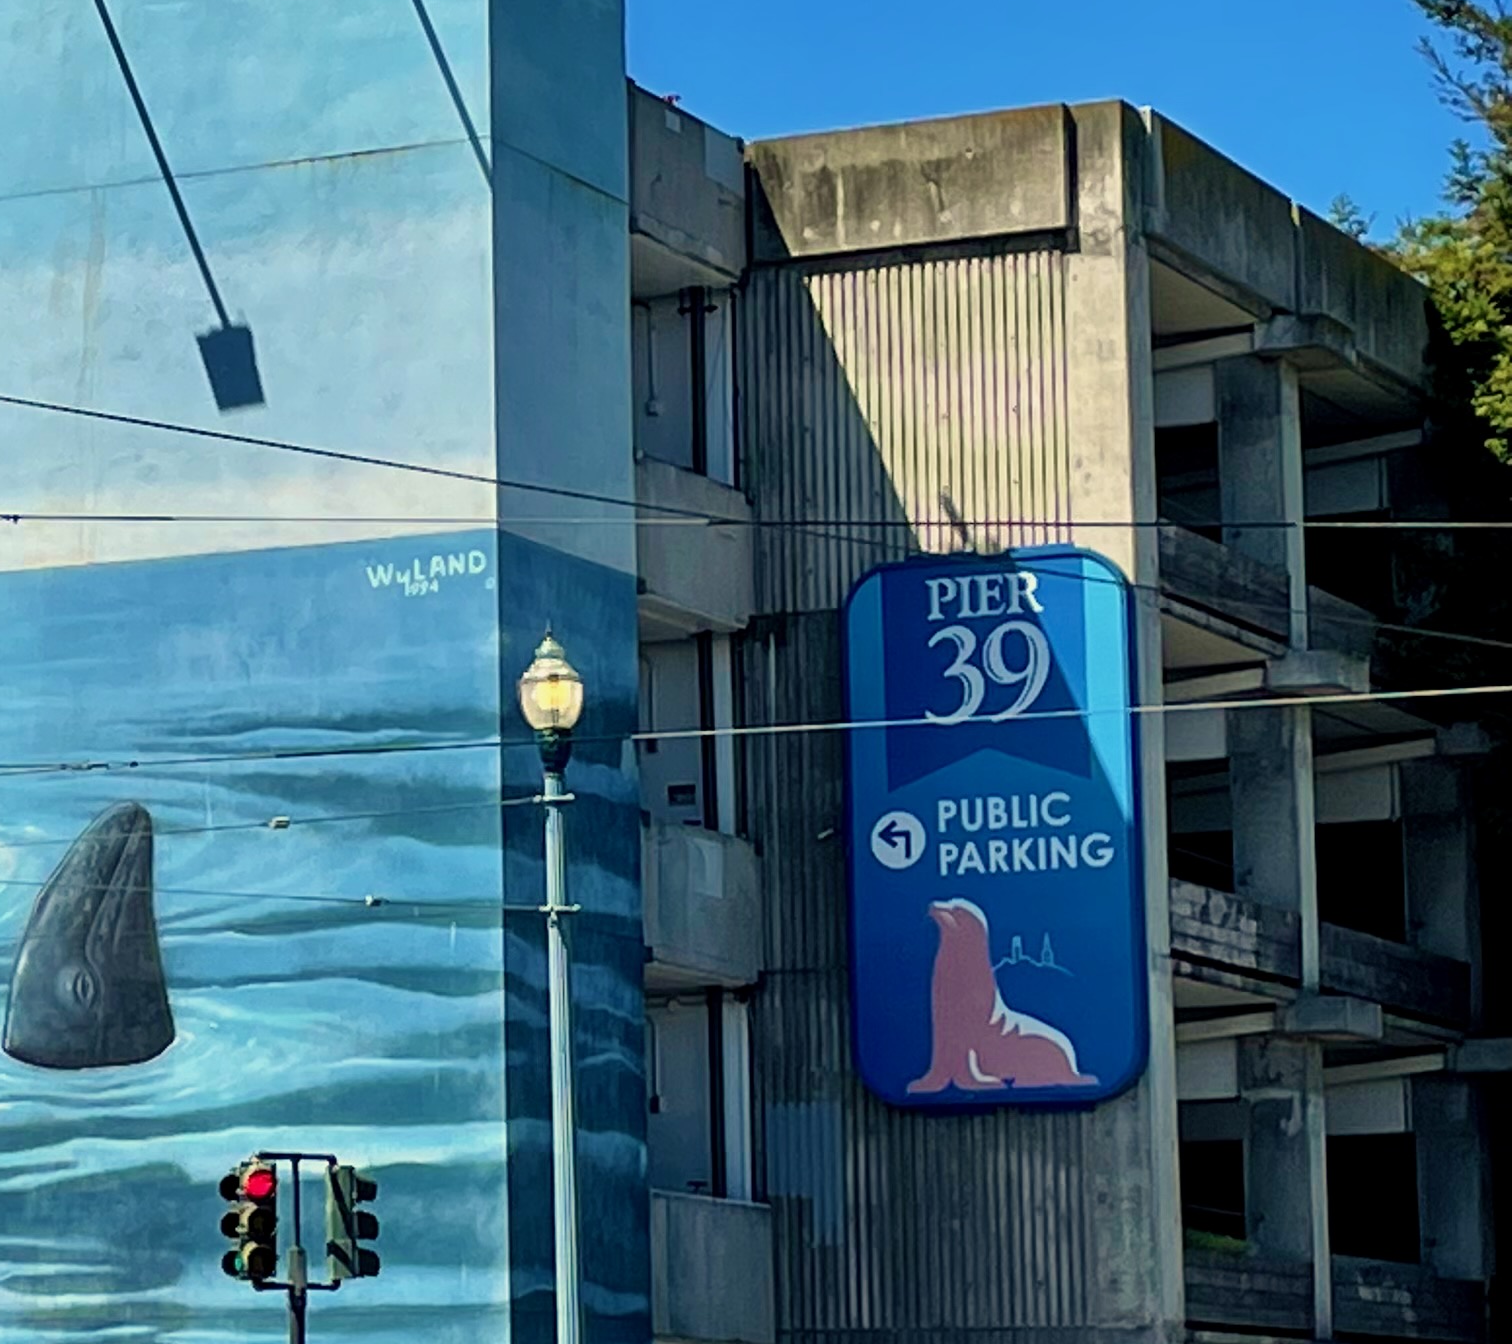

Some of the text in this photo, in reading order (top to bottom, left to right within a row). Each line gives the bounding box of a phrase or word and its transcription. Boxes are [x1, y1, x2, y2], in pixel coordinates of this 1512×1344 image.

[925, 570, 1043, 622] PIER
[925, 620, 1050, 725] 39
[937, 792, 1072, 833] PUBLIC
[938, 832, 1115, 877] PARKING
